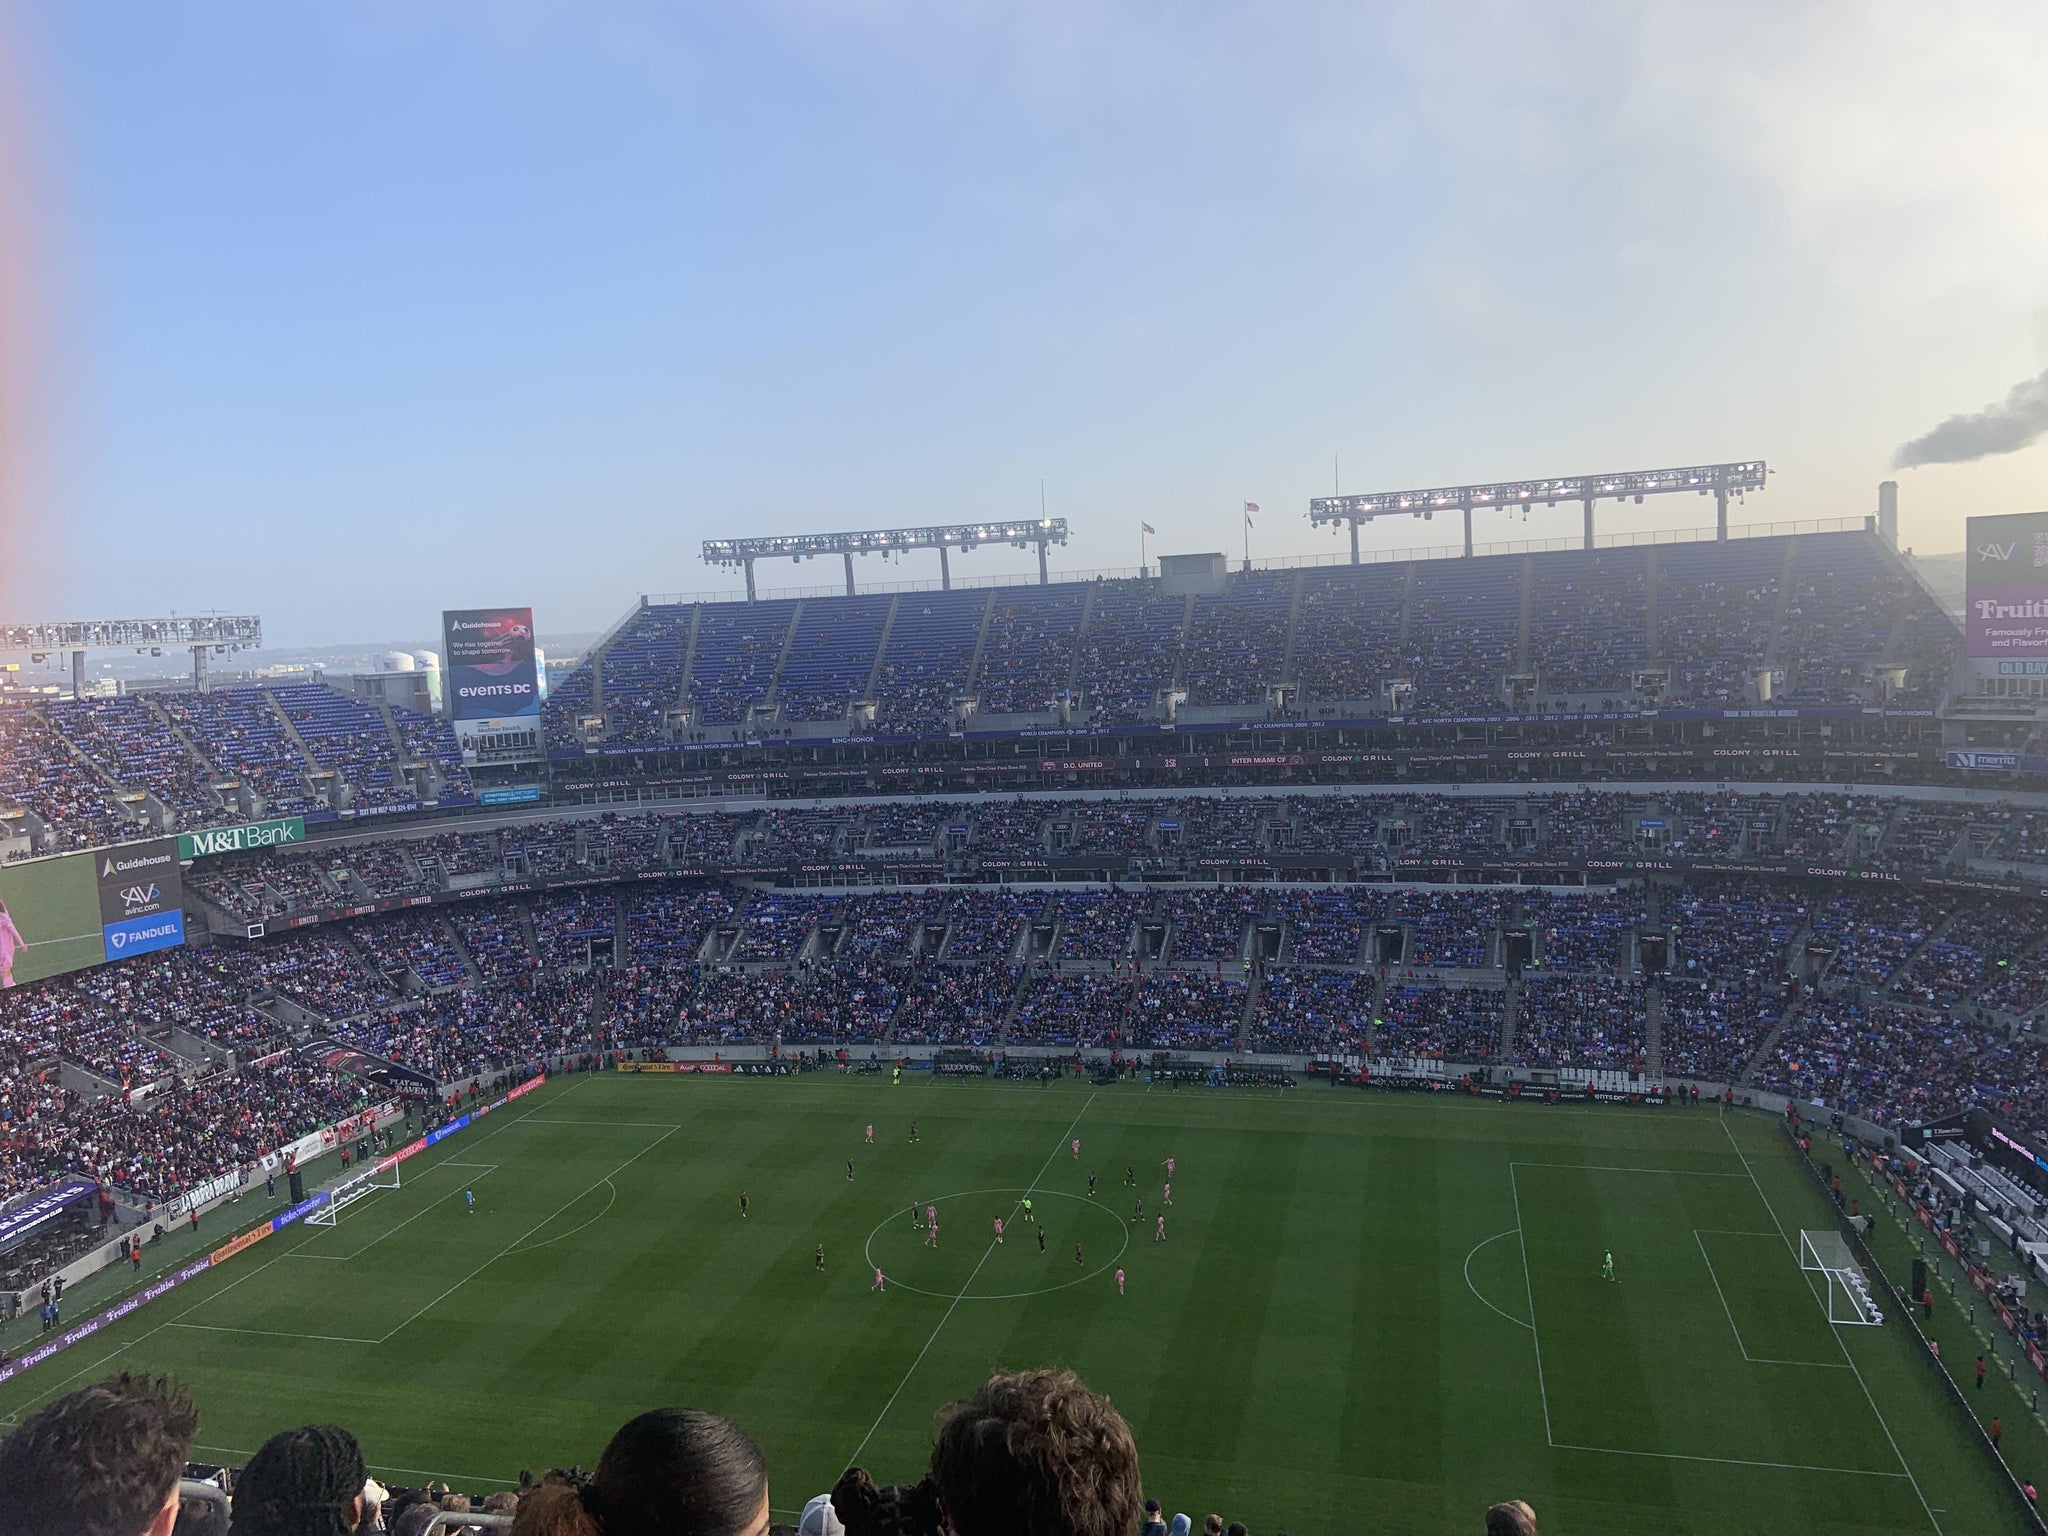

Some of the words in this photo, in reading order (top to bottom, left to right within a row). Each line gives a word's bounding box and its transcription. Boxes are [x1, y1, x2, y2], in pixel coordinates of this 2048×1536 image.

[461, 622, 501, 630] Guidehouse
[1985, 628, 2032, 638] Famously
[477, 640, 503, 648] together
[1992, 638, 2010, 646] and
[2000, 662, 2023, 674] OLD
[2026, 662, 2048, 674] BAY
[513, 684, 530, 694] DC
[1164, 759, 1176, 768] 3:56
[1978, 756, 2016, 765] merritt
[564, 782, 594, 790] COLONY
[602, 780, 630, 788] GRILL
[190, 828, 245, 856] M&T
[246, 822, 295, 847] Bank
[116, 854, 171, 872] Guidehouse
[1587, 860, 1624, 868] COLONY
[1636, 861, 1672, 869] GRILL
[638, 871, 666, 879] COLONY
[676, 869, 704, 877] GRILL
[1808, 867, 1847, 877] COLONY
[1861, 871, 1900, 881] GRILL
[124, 883, 155, 906] AV
[460, 887, 491, 898] COLONY
[501, 884, 531, 892] GRILL
[411, 896, 432, 904] UNITED
[124, 902, 159, 916] avinc.com
[355, 905, 375, 916] UNITED
[299, 915, 318, 925] UNITED
[128, 924, 178, 944] FANDUEL
[396, 1086, 428, 1095] RAVEN
[17, 1214, 50, 1234] TOUCHDOWN
[50, 1206, 64, 1218] CLUB
[213, 1232, 251, 1262] Continental
[181, 1260, 210, 1280] Fruitist
[144, 1279, 175, 1300] Fruitist
[106, 1300, 138, 1321] Fruitist
[64, 1322, 98, 1345] Fruitist
[22, 1344, 57, 1368] Fruitist
